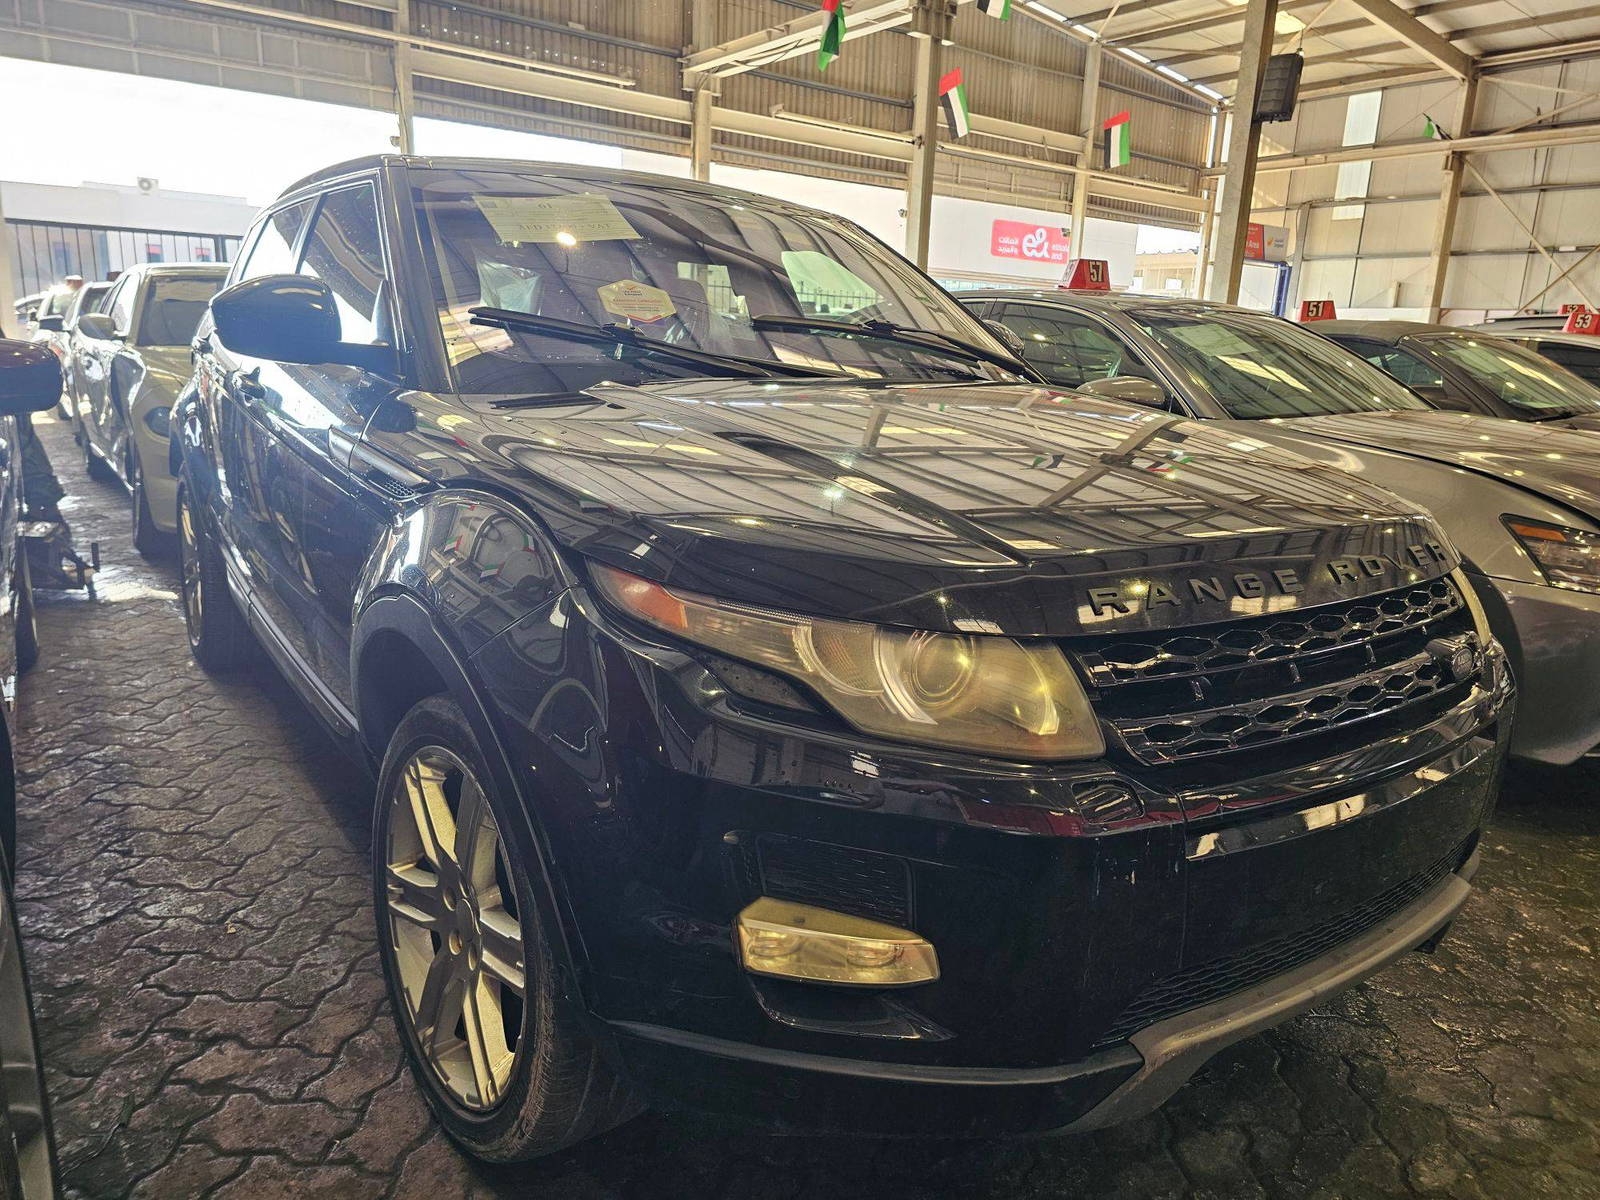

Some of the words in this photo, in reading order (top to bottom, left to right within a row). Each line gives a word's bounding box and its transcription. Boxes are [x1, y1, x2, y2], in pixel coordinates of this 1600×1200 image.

[1089, 260, 1103, 282] 57
[1308, 301, 1324, 317] 51
[1574, 314, 1593, 328] 53
[1086, 568, 1304, 616] RANGE
[1327, 541, 1449, 585] ROVER
